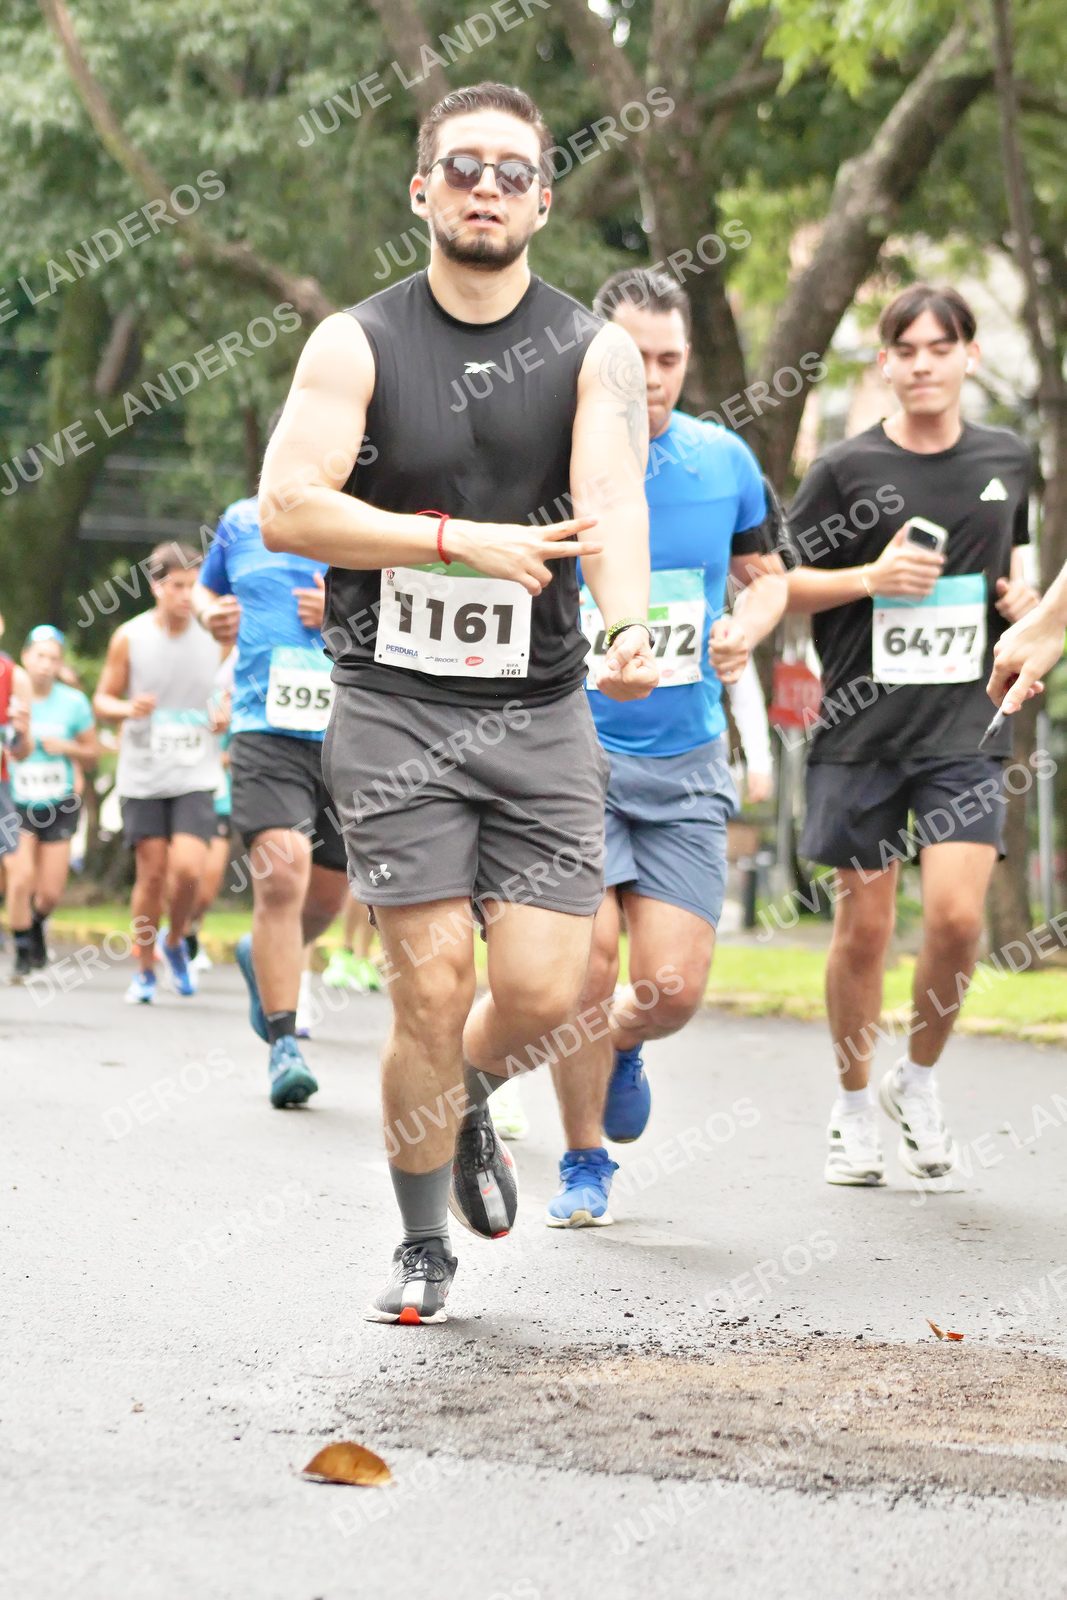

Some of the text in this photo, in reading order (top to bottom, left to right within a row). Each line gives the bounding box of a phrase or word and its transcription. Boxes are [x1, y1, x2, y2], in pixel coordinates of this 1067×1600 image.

[395, 591, 514, 645] 1161
[385, 643, 419, 658] PERDURA
[883, 625, 978, 657] 6477
